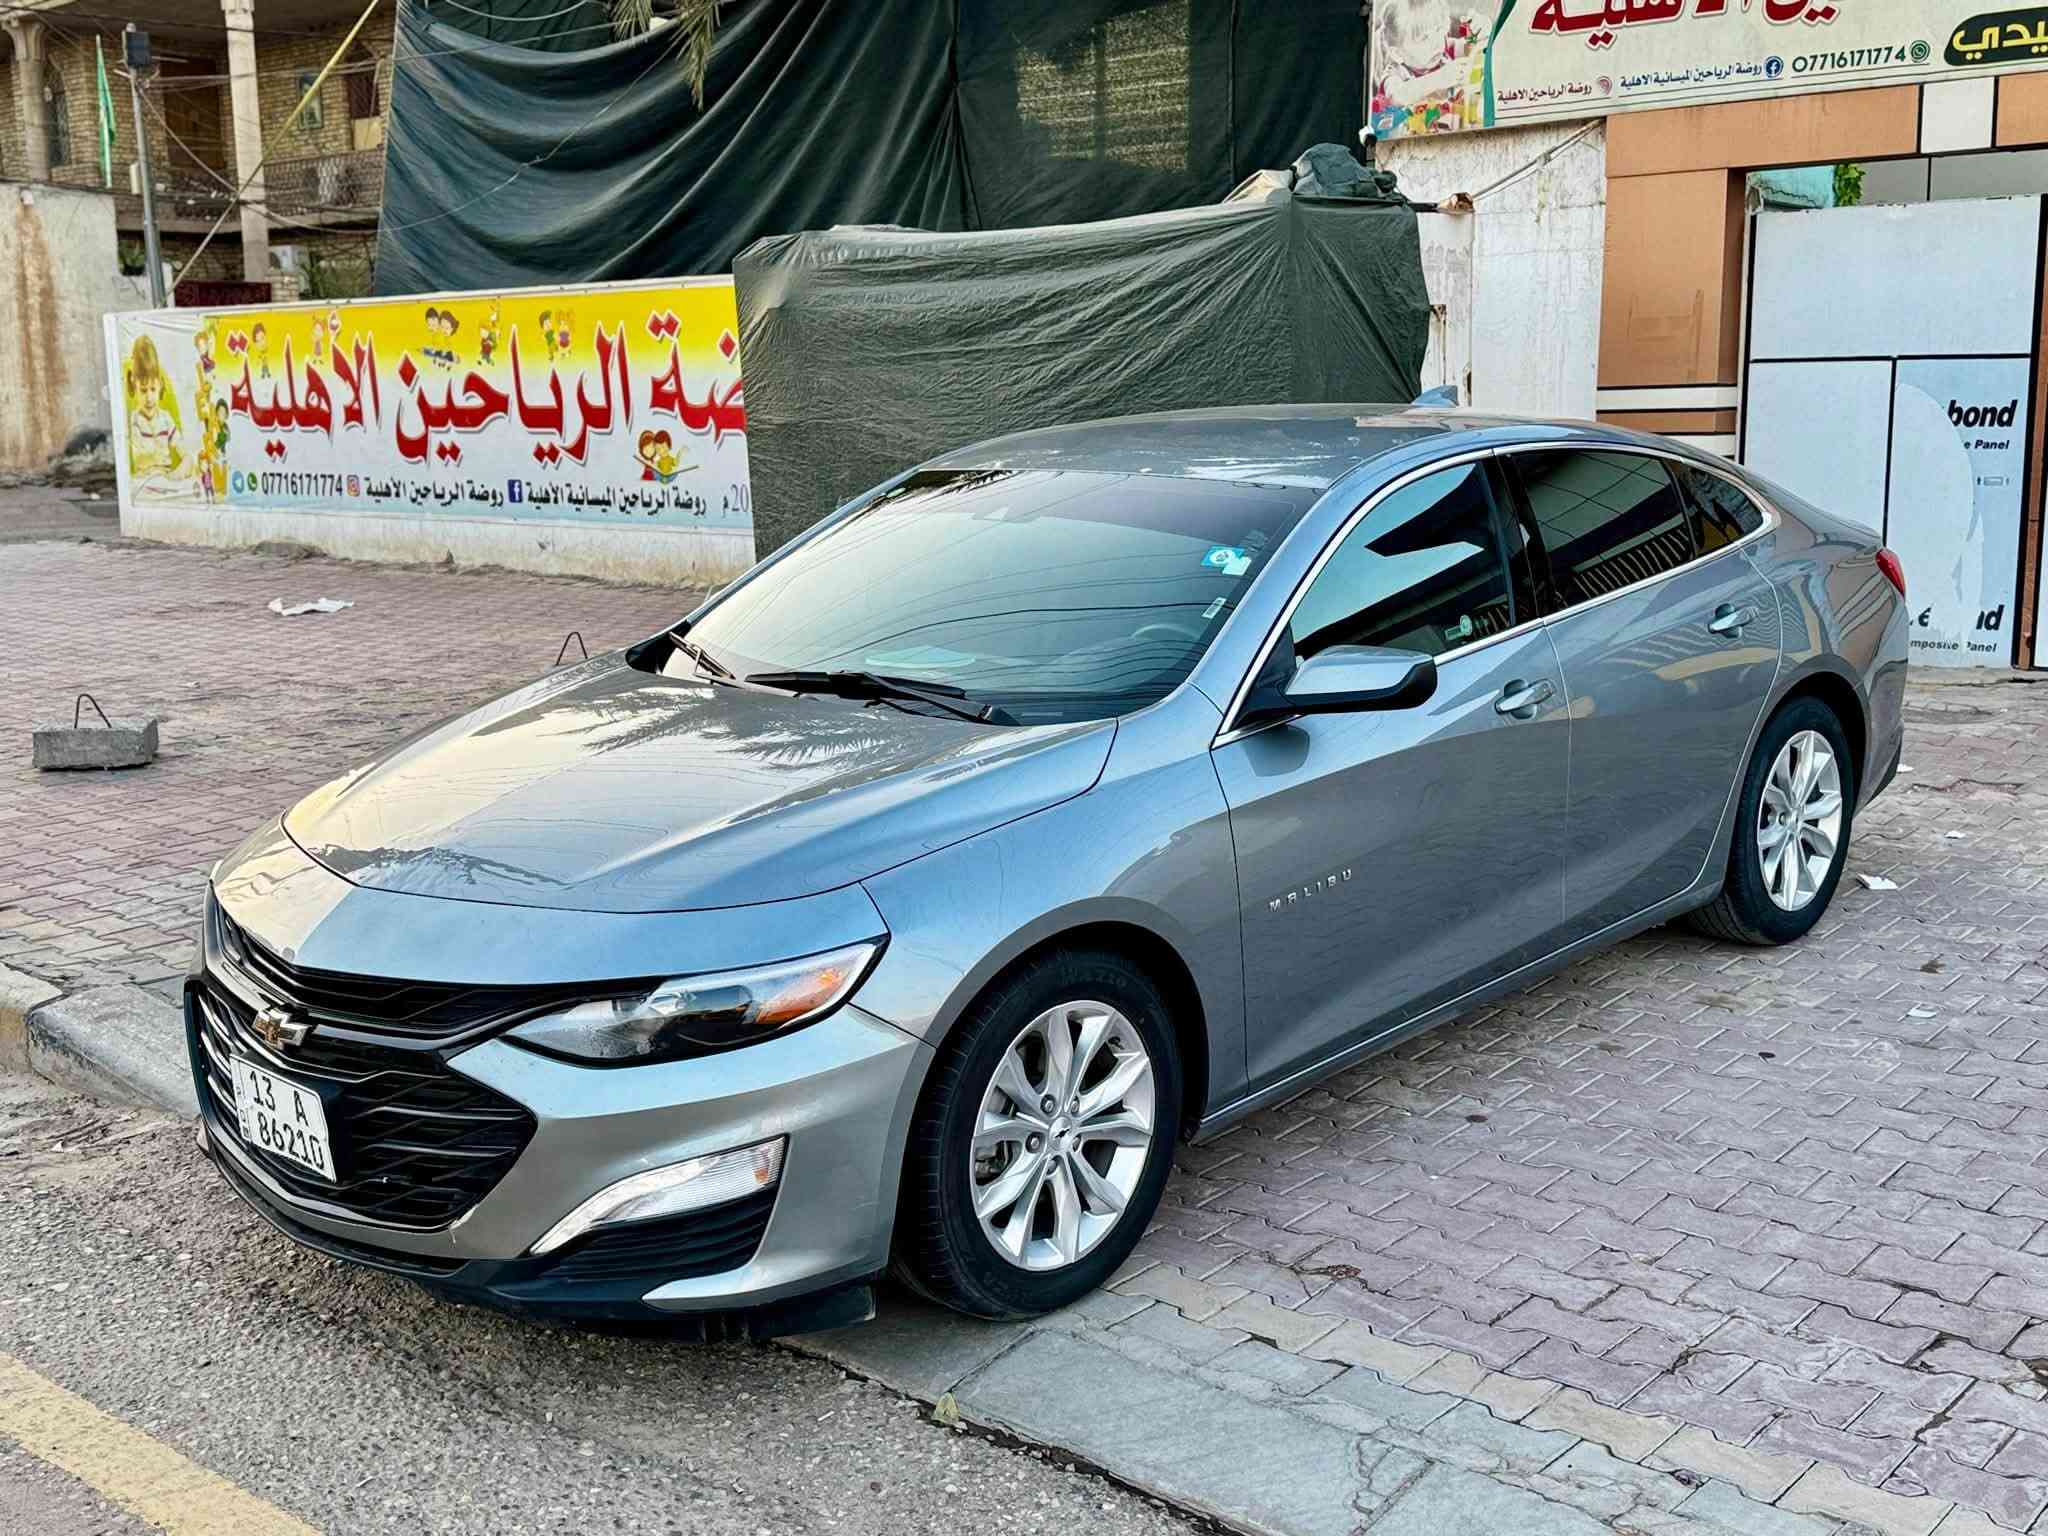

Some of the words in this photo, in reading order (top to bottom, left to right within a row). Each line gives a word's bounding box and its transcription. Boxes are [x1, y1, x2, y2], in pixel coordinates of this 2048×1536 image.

[1952, 20, 2048, 60] يدي
[1694, 65, 1735, 82] الرياحين
[1736, 62, 1763, 76] روضة
[1792, 46, 1906, 73] 07716171774
[1529, 84, 1567, 101] الرياحين
[1568, 82, 1592, 96] روضة
[227, 311, 381, 459] الأهلية
[647, 311, 748, 444] ضة
[396, 323, 632, 465] الرياحين
[1947, 399, 2018, 428] bond
[1974, 439, 2010, 450] Panel
[261, 472, 343, 497] 07716171774
[409, 479, 465, 507] الرياحين
[467, 479, 504, 507] روضة
[565, 483, 616, 513] الميسانية
[619, 485, 671, 515] الرياحين
[673, 486, 706, 515] روضة
[1269, 868, 1352, 912] MALIBU
[250, 1070, 275, 1111] 13
[294, 1090, 309, 1128] A
[257, 1111, 325, 1170] 86210
